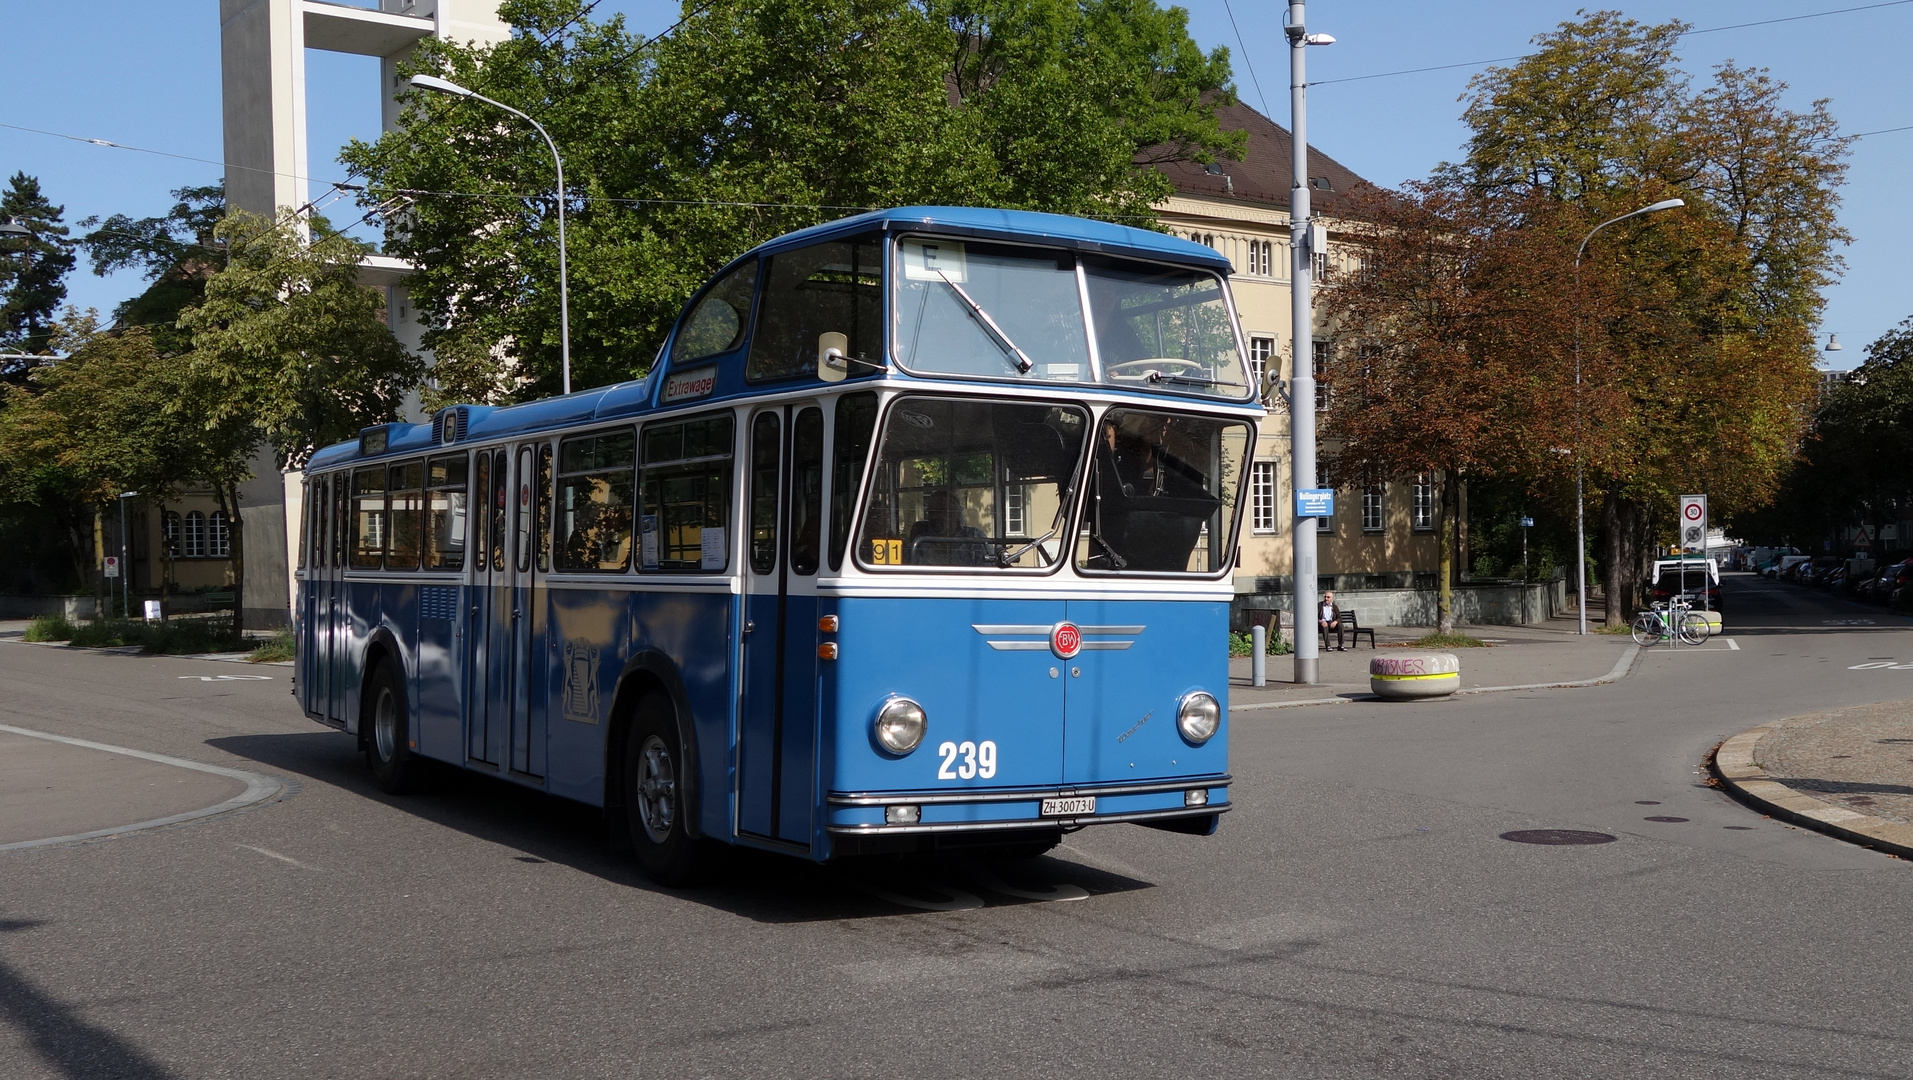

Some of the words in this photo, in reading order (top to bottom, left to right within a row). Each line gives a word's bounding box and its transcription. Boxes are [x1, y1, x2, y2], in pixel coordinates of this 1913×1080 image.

[1689, 508, 1698, 516] 30
[873, 543, 899, 561] 91
[938, 740, 997, 780] 239
